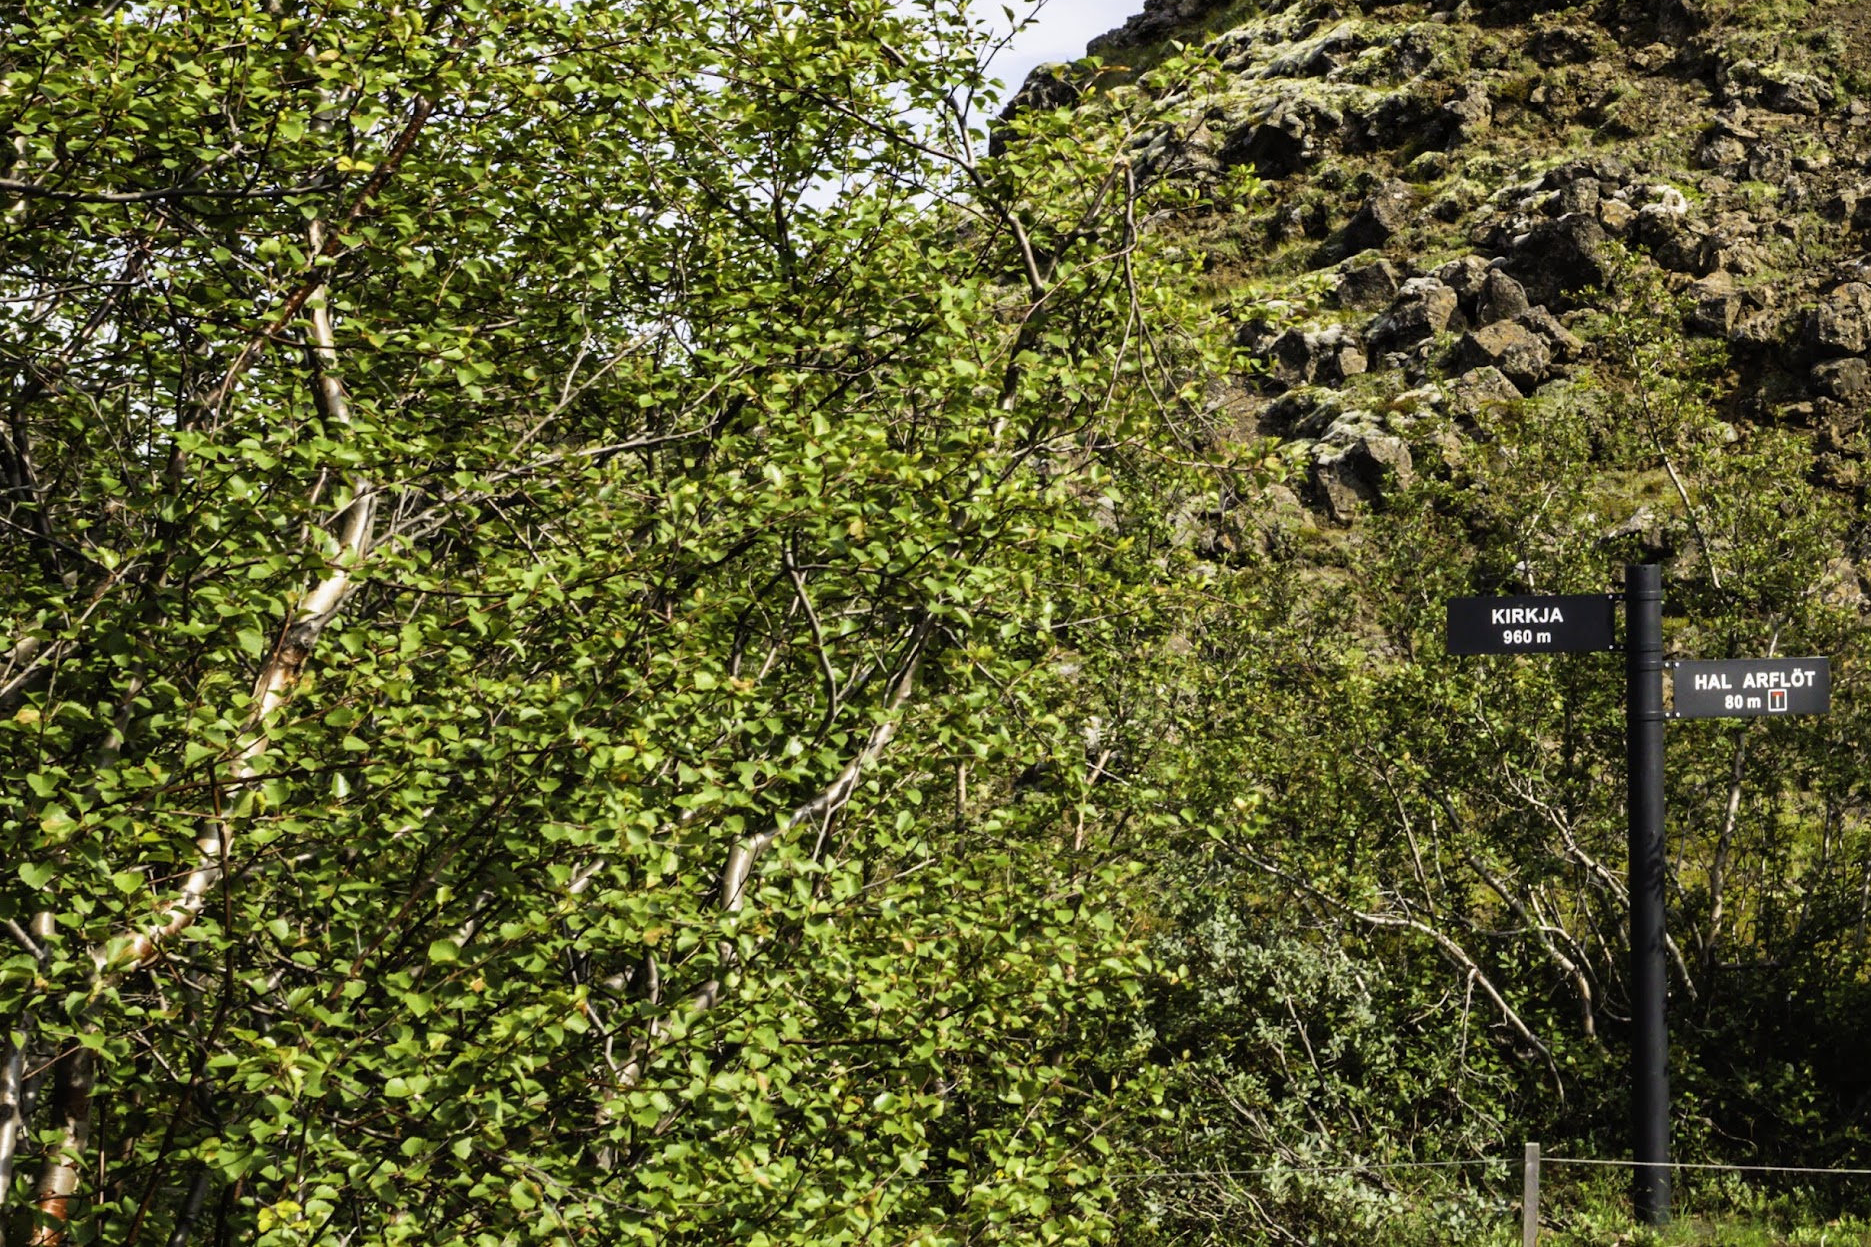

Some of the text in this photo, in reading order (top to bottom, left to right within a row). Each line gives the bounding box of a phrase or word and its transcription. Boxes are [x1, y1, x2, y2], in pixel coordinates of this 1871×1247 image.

[1491, 608, 1564, 625] KIRKJA
[1503, 629, 1552, 645] 960 m
[1742, 667, 1817, 690] ARFLÖT
[1724, 694, 1762, 710] 80 m
